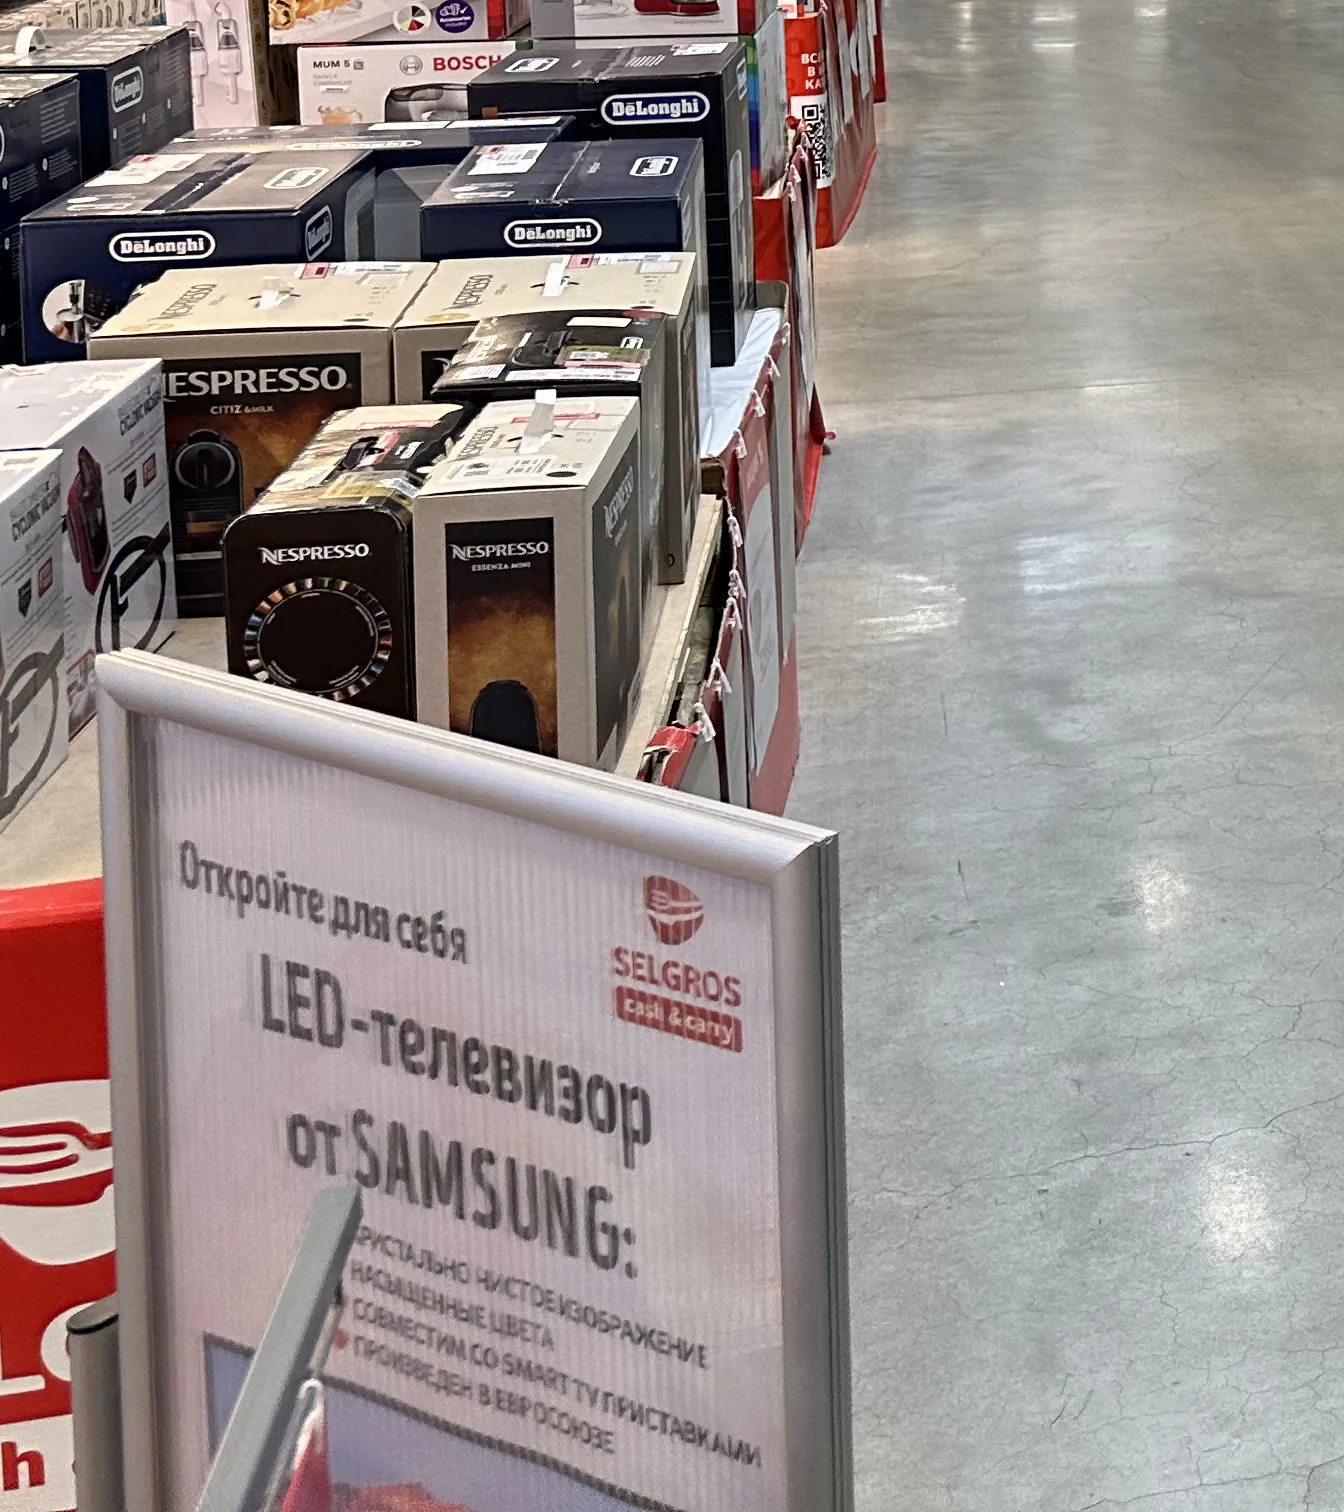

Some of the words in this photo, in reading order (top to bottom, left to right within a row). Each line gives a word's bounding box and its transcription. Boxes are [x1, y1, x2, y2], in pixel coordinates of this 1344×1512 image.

[313, 60, 341, 69] MUM
[433, 55, 502, 71] BOSCH
[163, 365, 347, 402] ESPRESSO
[258, 543, 370, 565] NESPRESSO
[448, 541, 549, 561] NESPRESSO
[179, 840, 326, 924] Откройте
[331, 894, 390, 943] для
[396, 909, 469, 964] себя
[611, 945, 742, 1008] SELGROS
[622, 992, 662, 1025] cash
[259, 952, 653, 1170] LED-телевизор
[286, 1111, 342, 1176] от
[350, 1108, 638, 1280] SAMSUNG:
[356, 1226, 469, 1285] РИСТАЛЬНО
